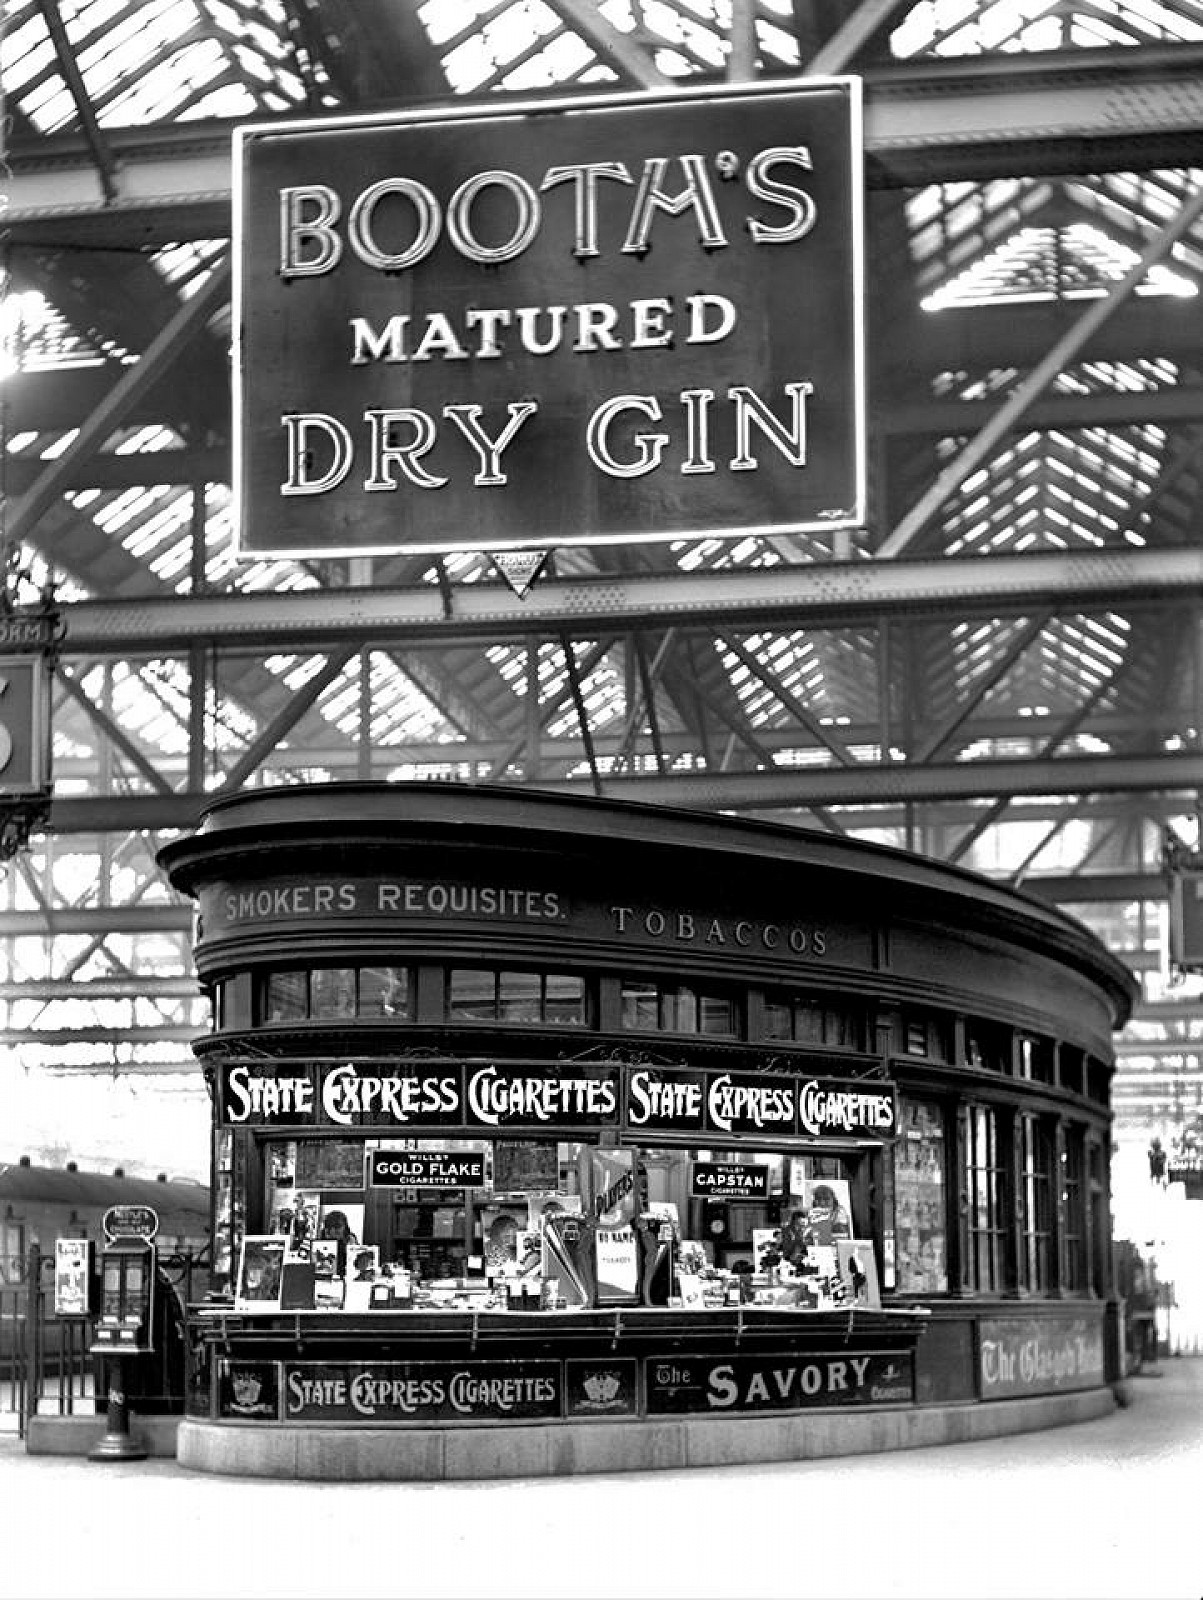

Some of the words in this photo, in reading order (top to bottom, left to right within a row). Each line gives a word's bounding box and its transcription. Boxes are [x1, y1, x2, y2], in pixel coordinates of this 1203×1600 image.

[279, 146, 817, 276] BOOTH'S
[349, 294, 737, 365] MATURED
[280, 402, 538, 495] DRY
[586, 382, 813, 478] GIN
[226, 884, 356, 921] SMOKERS
[378, 885, 567, 919] REQUISITES.
[611, 906, 826, 955] TOBACCOS
[227, 1066, 314, 1122] STATE
[322, 1063, 459, 1125] EXPRESS
[468, 1065, 616, 1126] CIGARETTES
[629, 1071, 702, 1124] STATE
[708, 1074, 794, 1132] EXPRESS
[800, 1079, 894, 1136] CIGARETTES
[376, 1162, 424, 1176] GOLD
[429, 1163, 481, 1176] FLAKE
[399, 1176, 458, 1184] CIGARETTES
[696, 1173, 764, 1188] CAPSTAN
[289, 1371, 347, 1413] STATE
[351, 1371, 446, 1415] EXPRESS
[450, 1371, 556, 1413] CIGARETTES
[656, 1365, 691, 1384] The
[707, 1357, 870, 1408] SAVORY
